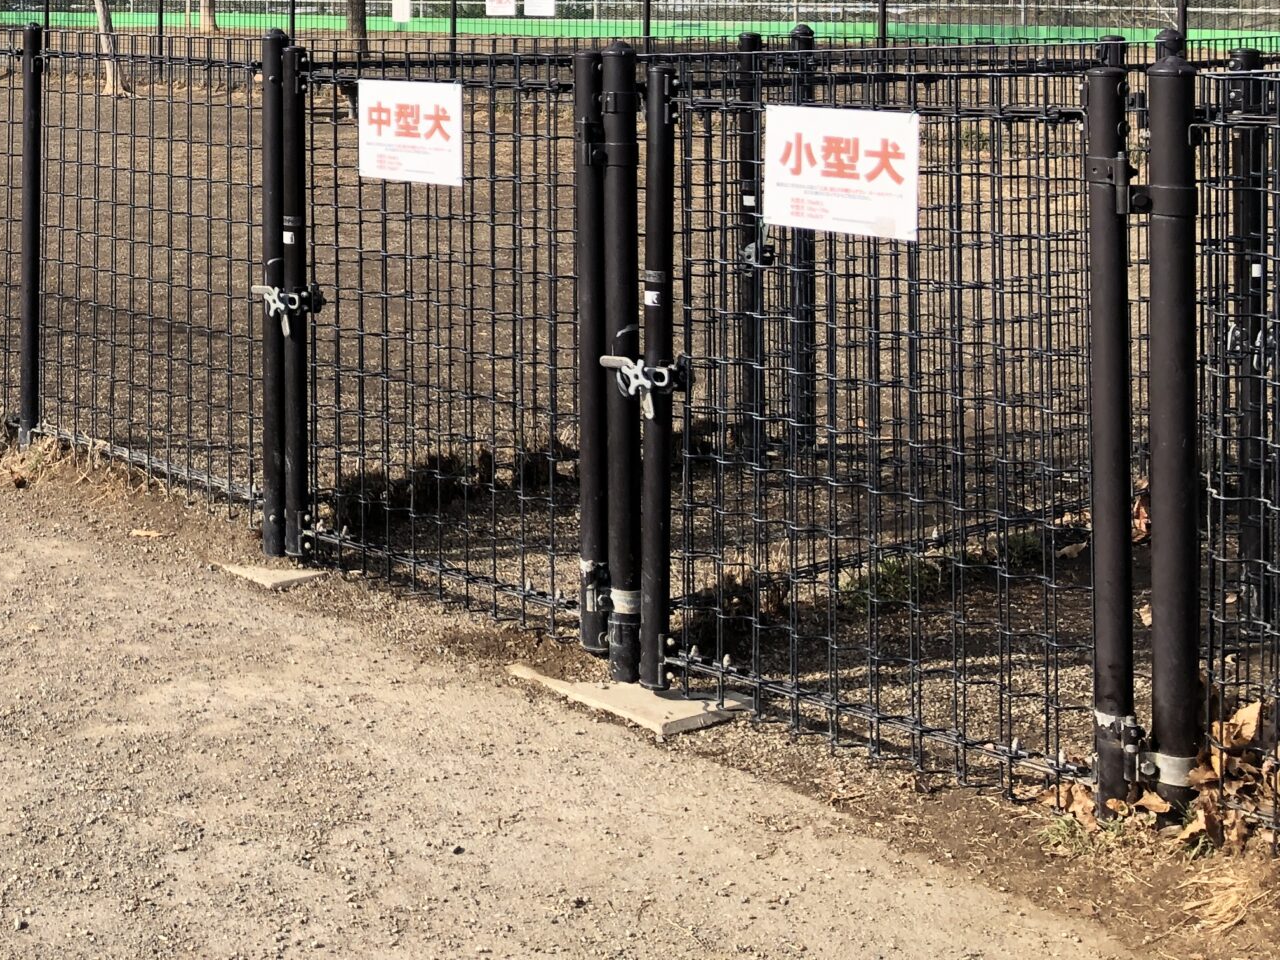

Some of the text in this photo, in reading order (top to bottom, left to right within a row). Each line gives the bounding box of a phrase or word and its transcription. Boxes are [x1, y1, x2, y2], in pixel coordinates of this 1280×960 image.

[367, 101, 451, 142] 中型犬
[779, 132, 906, 185] 小型犬
